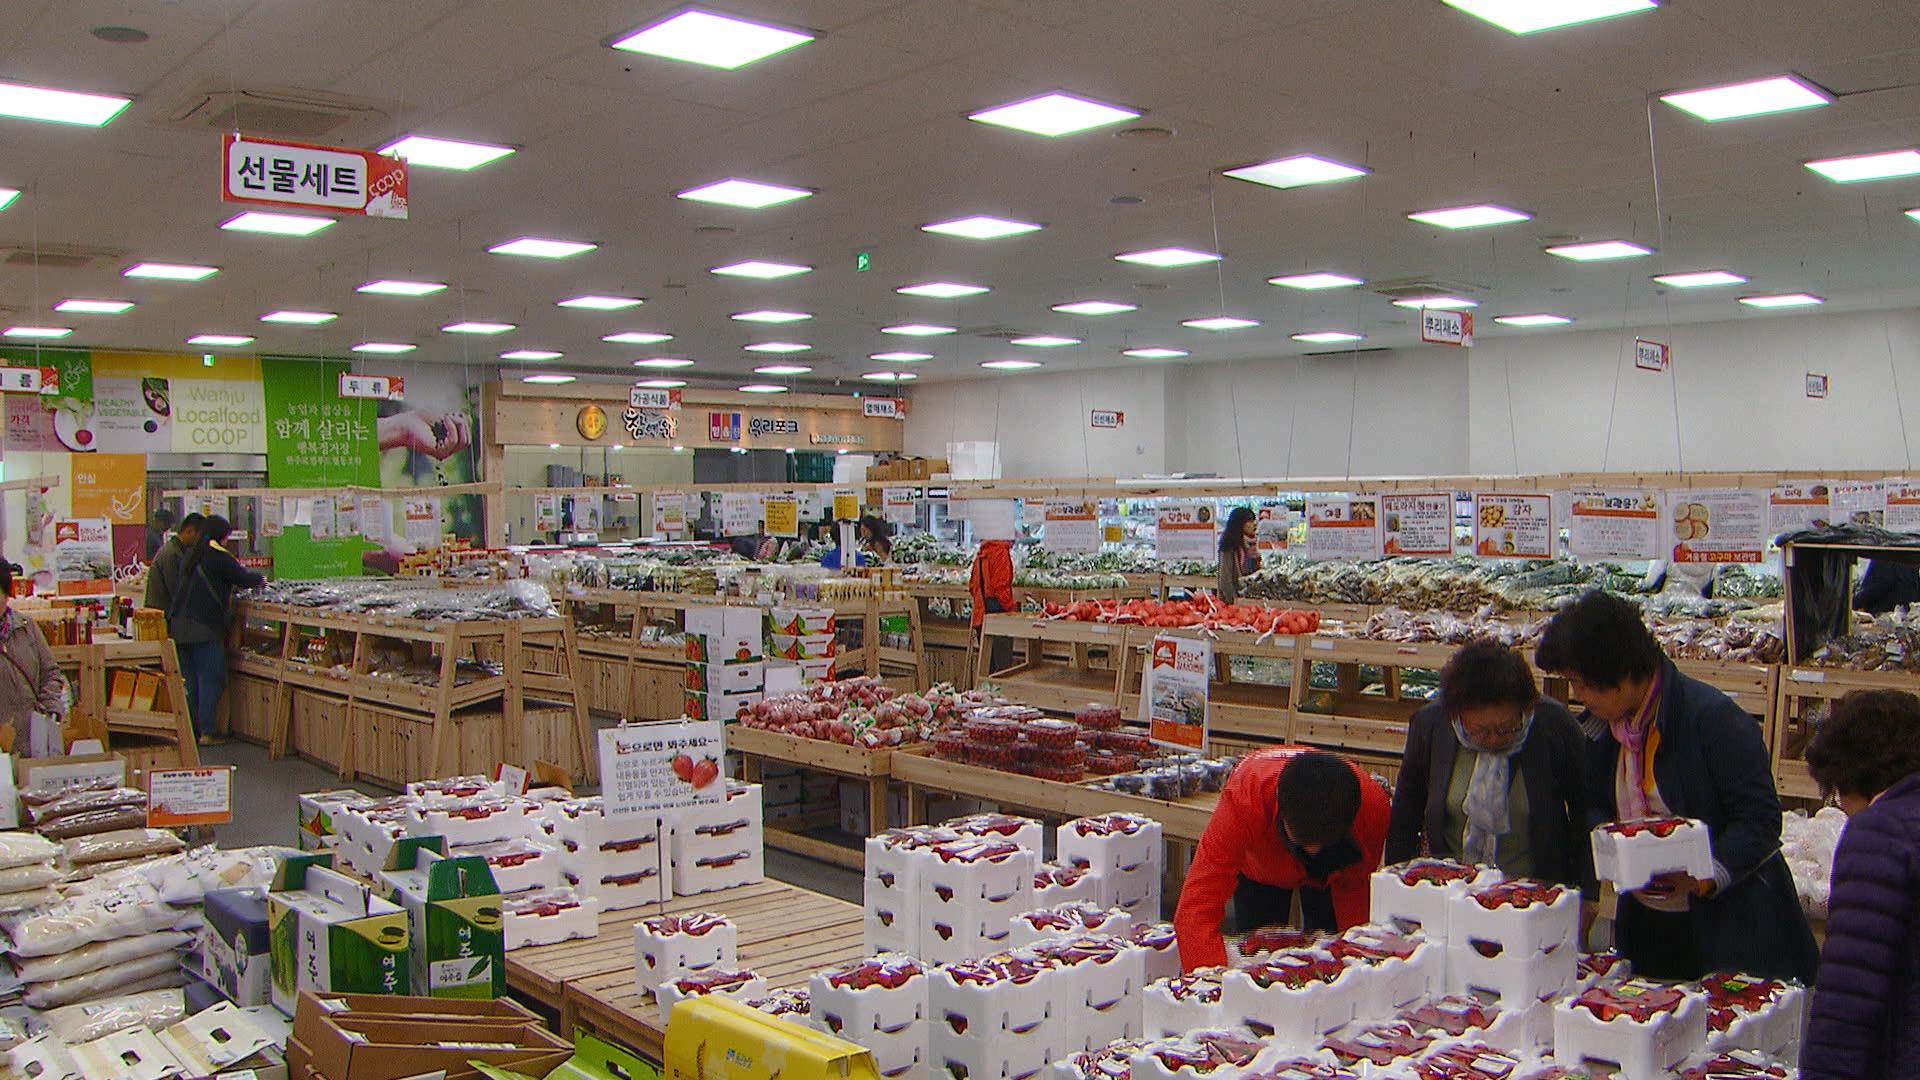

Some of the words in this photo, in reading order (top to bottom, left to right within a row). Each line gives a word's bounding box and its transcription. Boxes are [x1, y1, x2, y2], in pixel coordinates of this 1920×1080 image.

[238, 155, 360, 197] 선물세트
[1425, 316, 1460, 337] 뿌리채소
[189, 385, 246, 406] Wanju
[633, 393, 667, 406] 가공식품
[191, 428, 248, 445] COOP
[274, 418, 310, 440] 함께
[317, 418, 369, 441] 살리는
[1709, 552, 1732, 561] 고구마
[616, 740, 663, 755] 눈으로만
